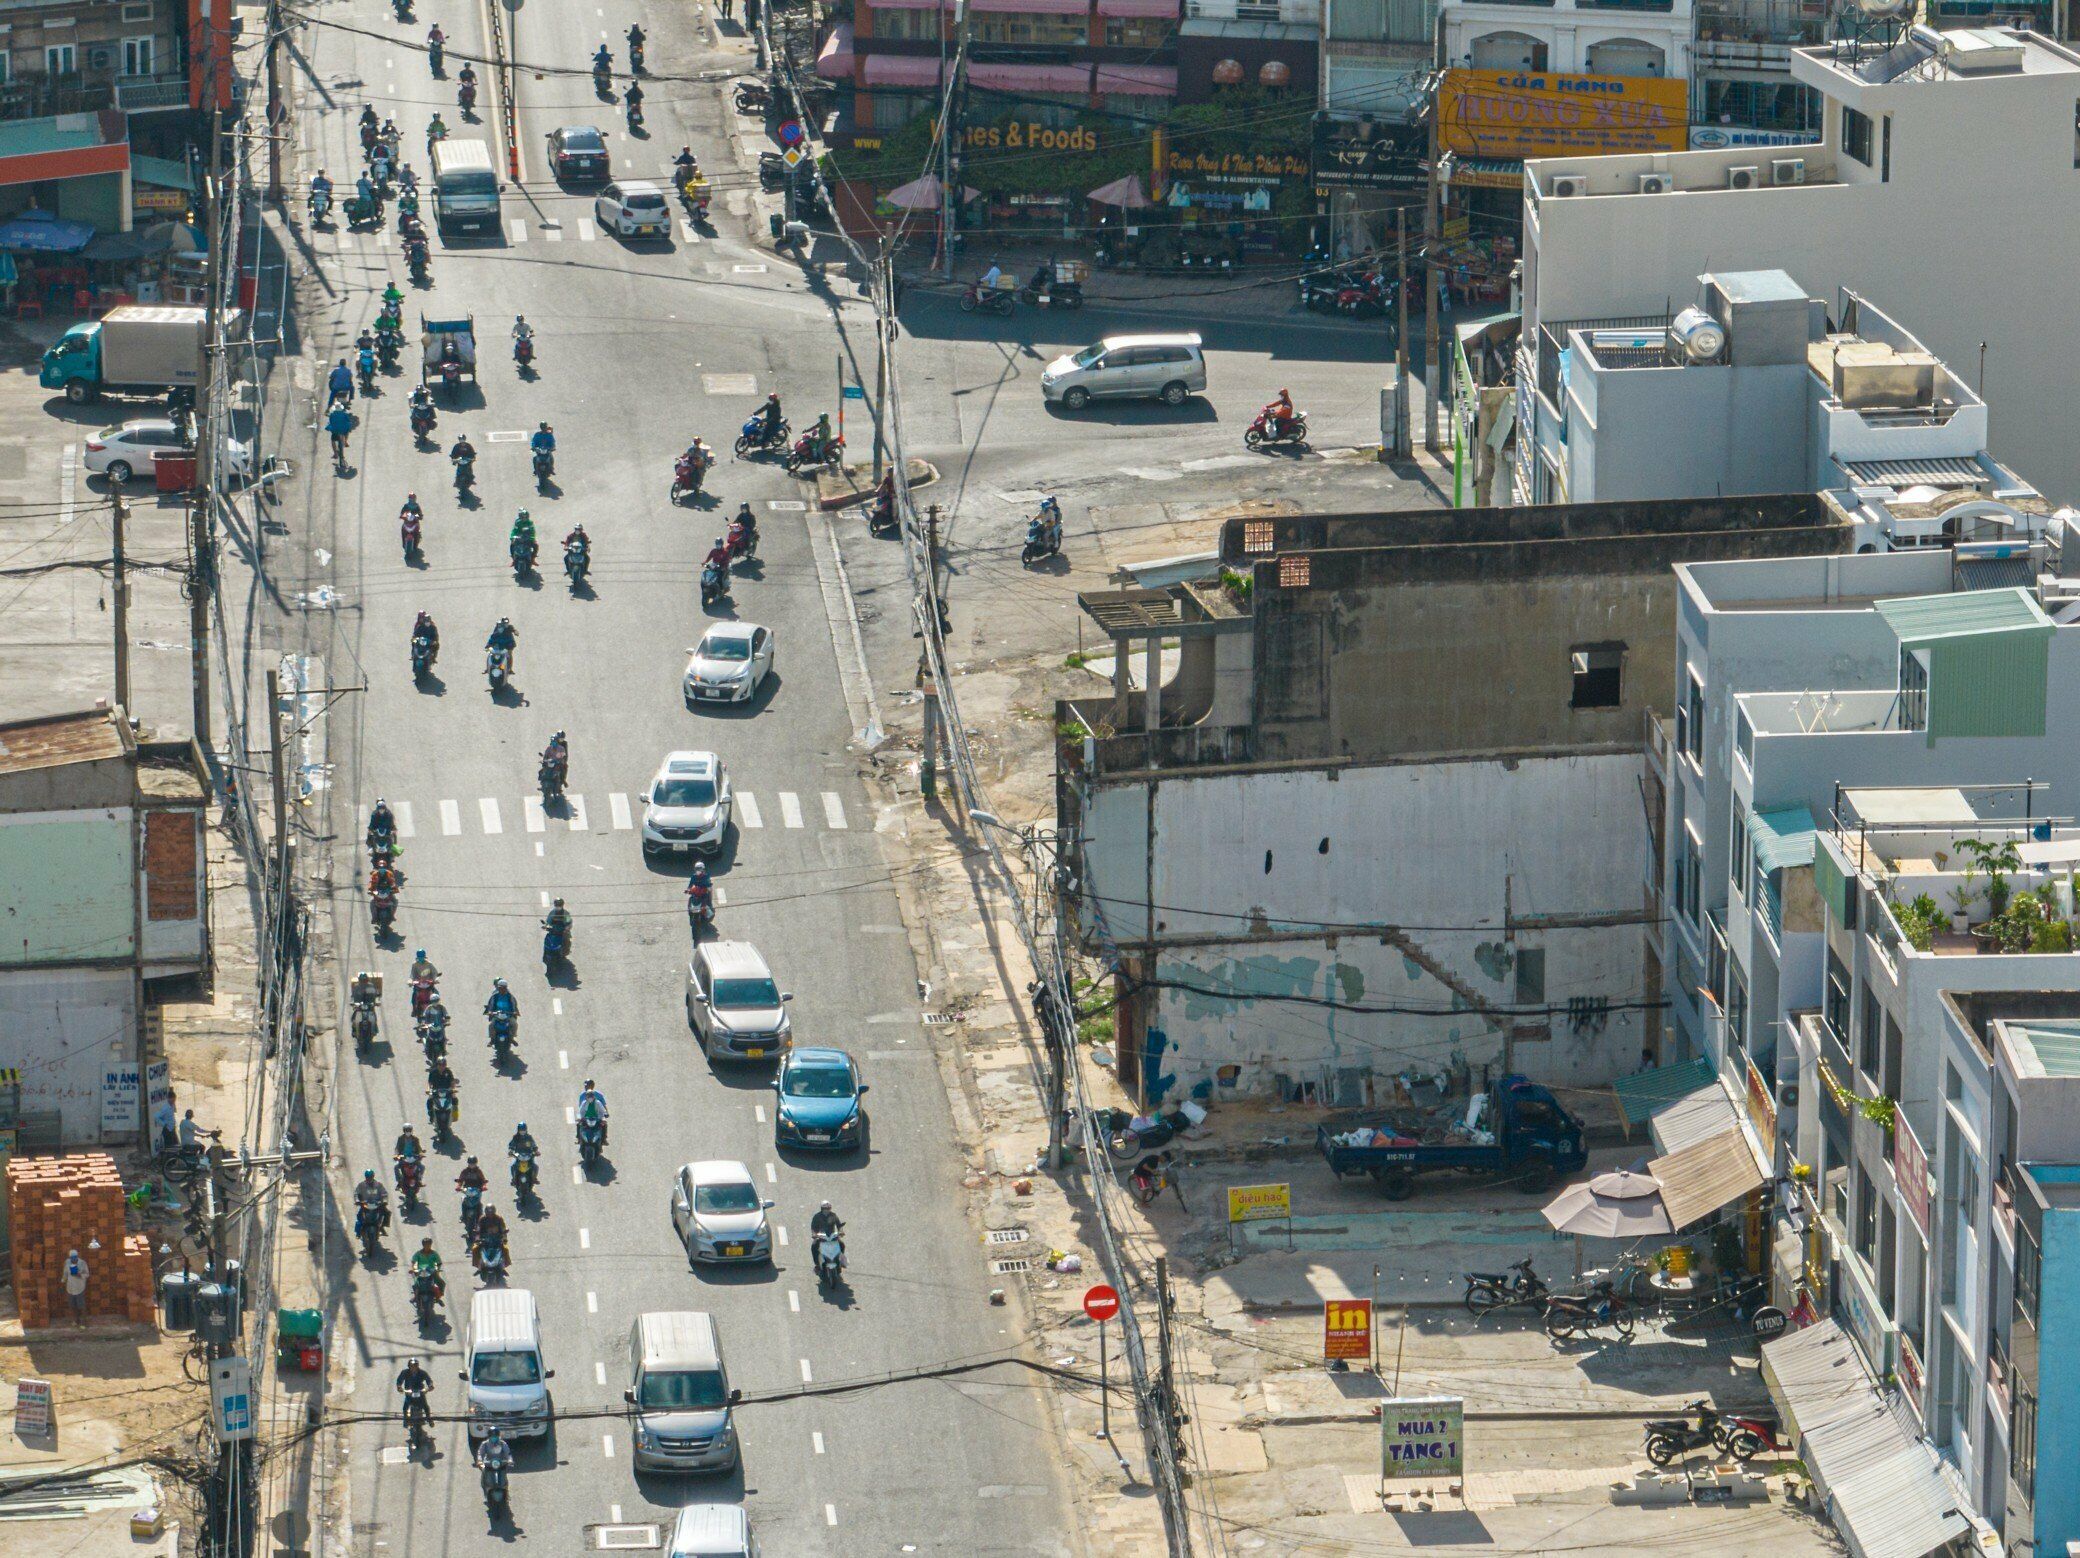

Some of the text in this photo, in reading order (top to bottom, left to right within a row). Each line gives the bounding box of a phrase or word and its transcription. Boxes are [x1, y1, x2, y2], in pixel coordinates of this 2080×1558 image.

[1006, 121, 1022, 147] &
[1028, 123, 1097, 151] Foods
[1206, 175, 1222, 183] VINS
[1229, 176, 1281, 184] ALIMENTATIONS
[107, 1073, 118, 1083] IN
[1328, 1302, 1368, 1330] in
[1764, 1315, 1784, 1328] VENUS
[1397, 1420, 1447, 1436] MUA 2
[1388, 1440, 1456, 1464] TẶNG 1
